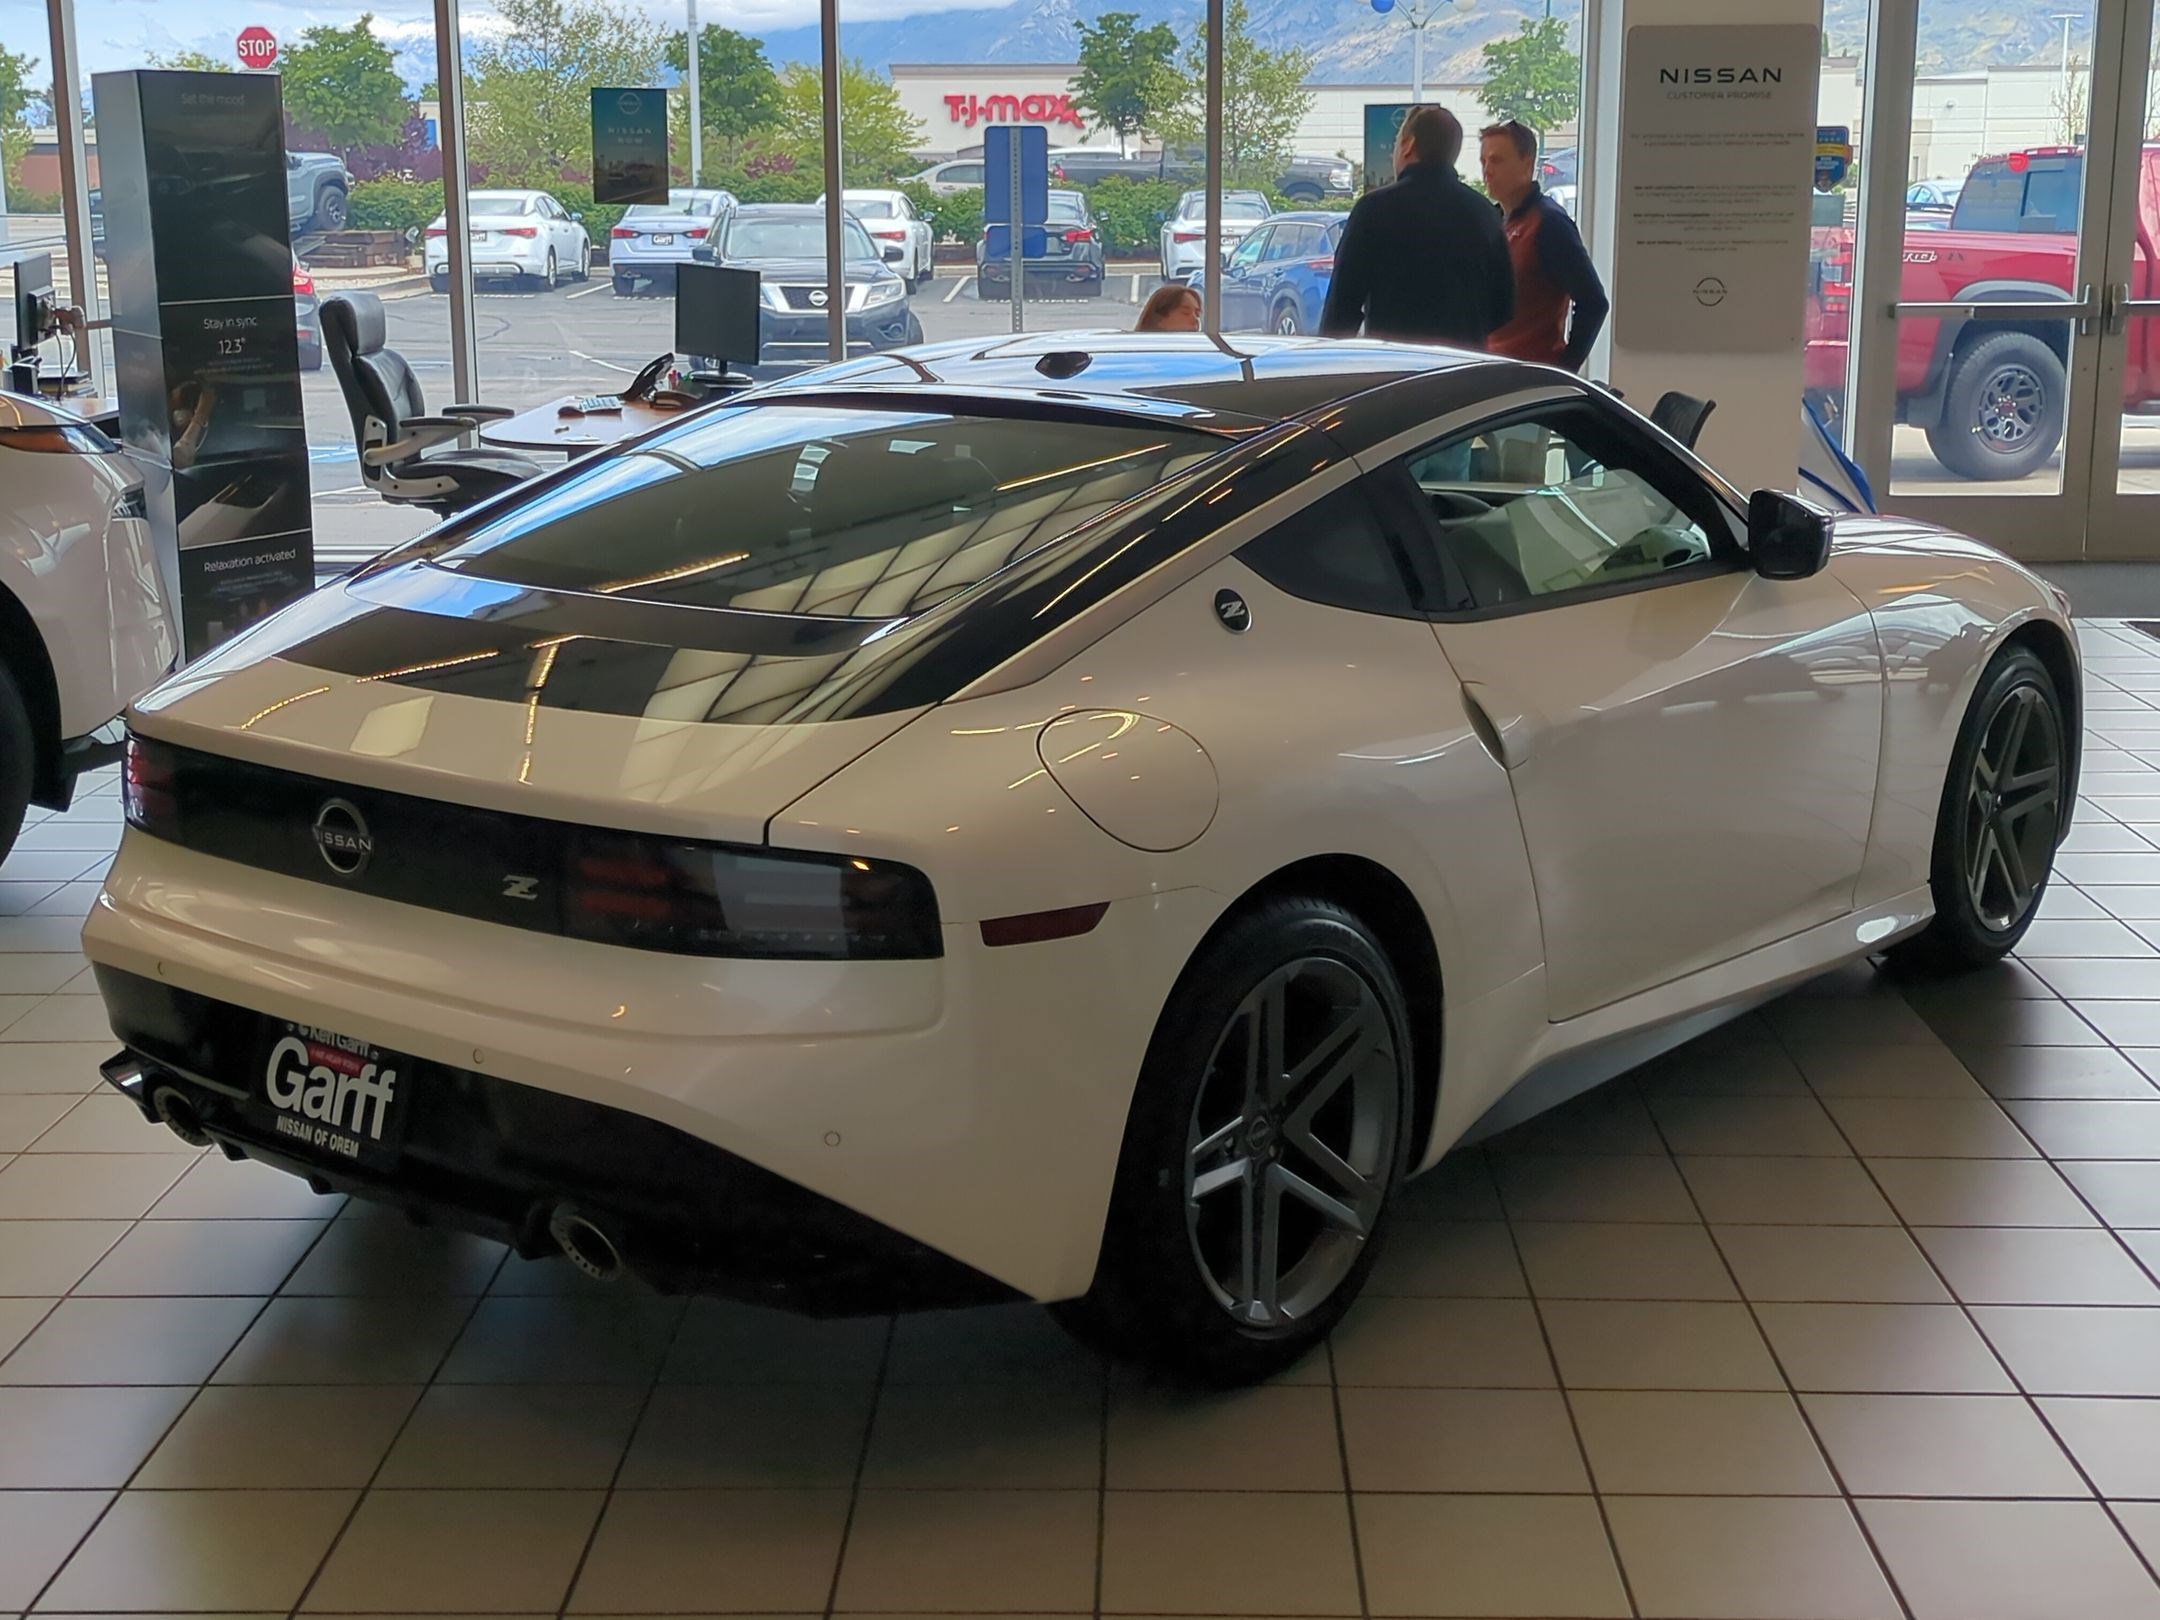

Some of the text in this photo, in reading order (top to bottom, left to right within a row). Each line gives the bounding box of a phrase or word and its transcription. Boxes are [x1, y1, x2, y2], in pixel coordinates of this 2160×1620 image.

[239, 39, 275, 57] STOP
[1660, 67, 1782, 84] NISSAN
[1666, 90, 1772, 100] CUSTOMER PROMISE
[607, 127, 652, 135] NISSAN
[203, 316, 258, 330] Stay in sync
[203, 548, 297, 573] Relaxation activated
[1220, 600, 1246, 619] Z
[313, 825, 373, 852] NISSAN
[501, 874, 540, 900] Z
[309, 1026, 336, 1047] Ken
[266, 1036, 396, 1140] Garff
[276, 1115, 360, 1159] NISSAN OF OREM
